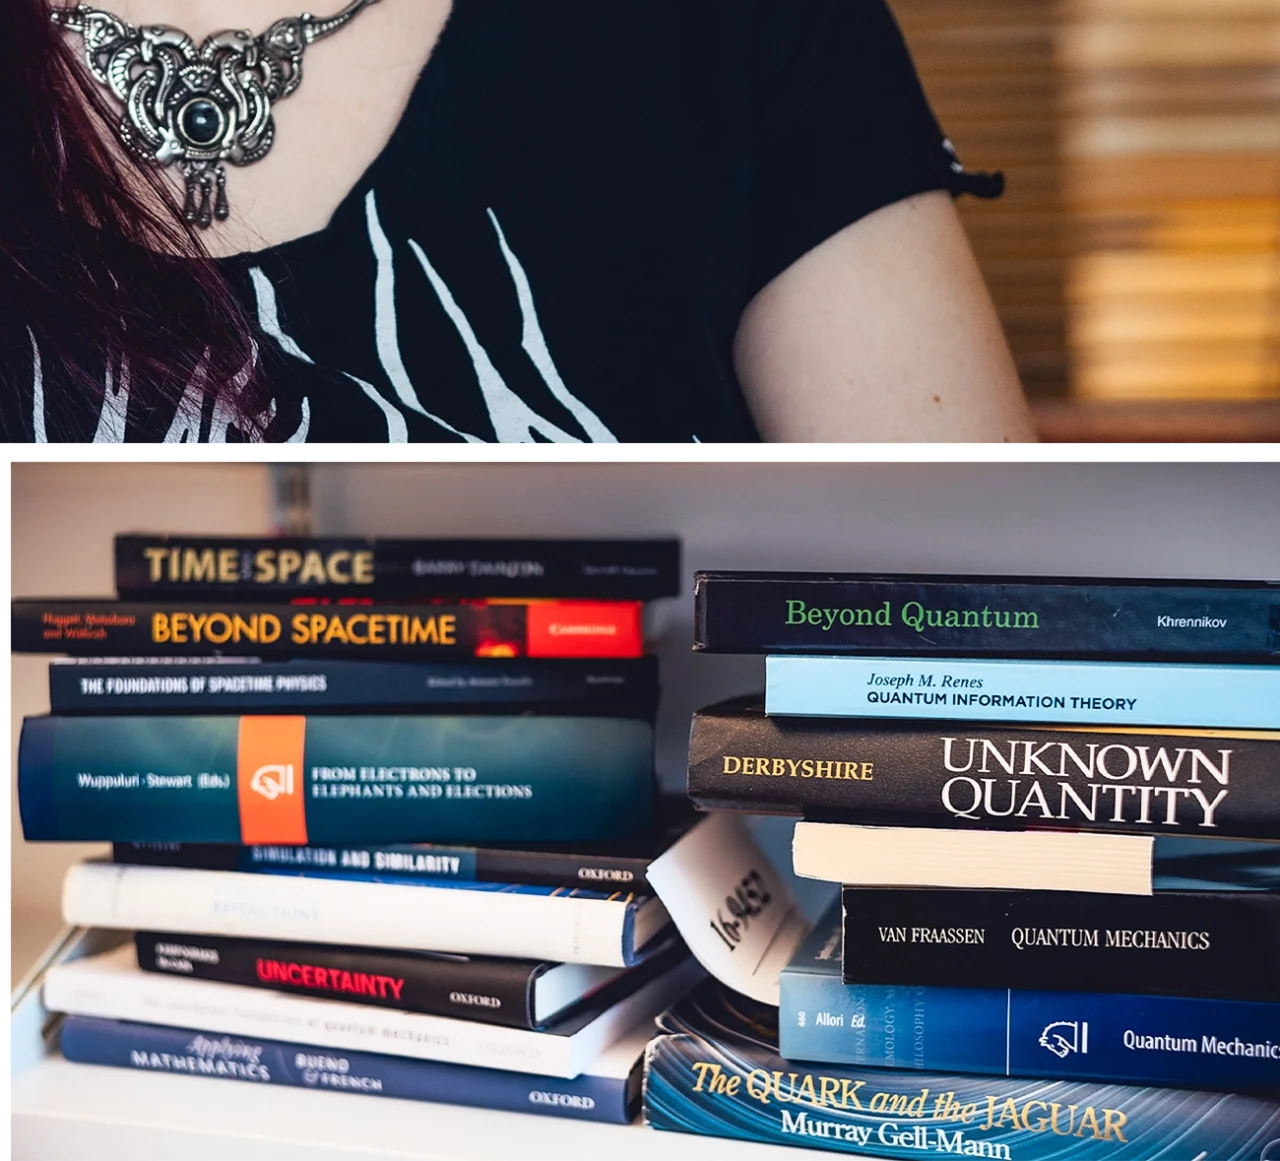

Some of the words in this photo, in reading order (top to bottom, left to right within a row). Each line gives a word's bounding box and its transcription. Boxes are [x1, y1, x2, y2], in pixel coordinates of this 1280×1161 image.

[143, 547, 239, 583] TIME
[254, 549, 375, 584] SPACE
[785, 599, 892, 631] Beyond
[901, 601, 1040, 632] Quantum
[1157, 615, 1227, 628] Khrennikov
[152, 612, 282, 643] BEYOND
[291, 613, 456, 645] SPACETIME
[81, 677, 104, 695] THE
[106, 676, 188, 694] FOUNDATIONS
[189, 676, 206, 693] OF
[209, 675, 273, 692] SPACETIME
[275, 674, 327, 691] PHYSICS
[867, 673, 914, 690] Joseph
[918, 674, 936, 687] M.
[941, 675, 984, 688] Renes
[867, 691, 947, 706] QUANTUM
[952, 693, 1065, 709] INFORMATION
[1070, 697, 1137, 710] THEORY
[722, 756, 874, 780] DERBYSHIRE
[941, 737, 1233, 785] UNKNOWN
[77, 773, 139, 790] Wuppuluri
[145, 773, 193, 789] Stewart
[197, 773, 230, 789] (Eds.)
[312, 766, 356, 782] FROM
[359, 766, 451, 782] ELECTRONS
[453, 766, 477, 782] TO
[312, 783, 403, 799] ELEPHANTS
[407, 783, 443, 799] AND
[445, 784, 533, 799] ELECTIONS
[941, 777, 1229, 827] QUANTITY
[251, 846, 337, 866] SIMULATION
[341, 849, 371, 868] AND
[374, 851, 460, 874] SIMILARITY
[578, 867, 634, 882] OXFORD
[878, 927, 907, 943] VAN
[912, 927, 985, 944] FRAASSEN
[1011, 927, 1099, 950] QUANTUM
[1105, 929, 1210, 950] MECHANICS
[256, 957, 405, 1001] UNCERTAINTY
[449, 992, 501, 1008] OXFORD
[815, 1012, 844, 1027] Allori
[851, 1014, 866, 1028] Ed.
[186, 1034, 263, 1065] Applying
[1123, 1029, 1197, 1053] Quantum
[1201, 1035, 1280, 1060] Mechanic
[130, 1050, 271, 1081] MATHEMATICS
[294, 1053, 350, 1073] BUENO
[321, 1072, 383, 1091] FRENCH
[528, 1090, 595, 1110] OXFORD
[691, 1061, 741, 1096] The
[746, 1069, 866, 1110] QUARK
[870, 1089, 929, 1119] and
[932, 1091, 977, 1124] the
[979, 1095, 1128, 1143] JAGUAR
[780, 1109, 873, 1146] Murray
[878, 1122, 1011, 1160] Gell-Mann
